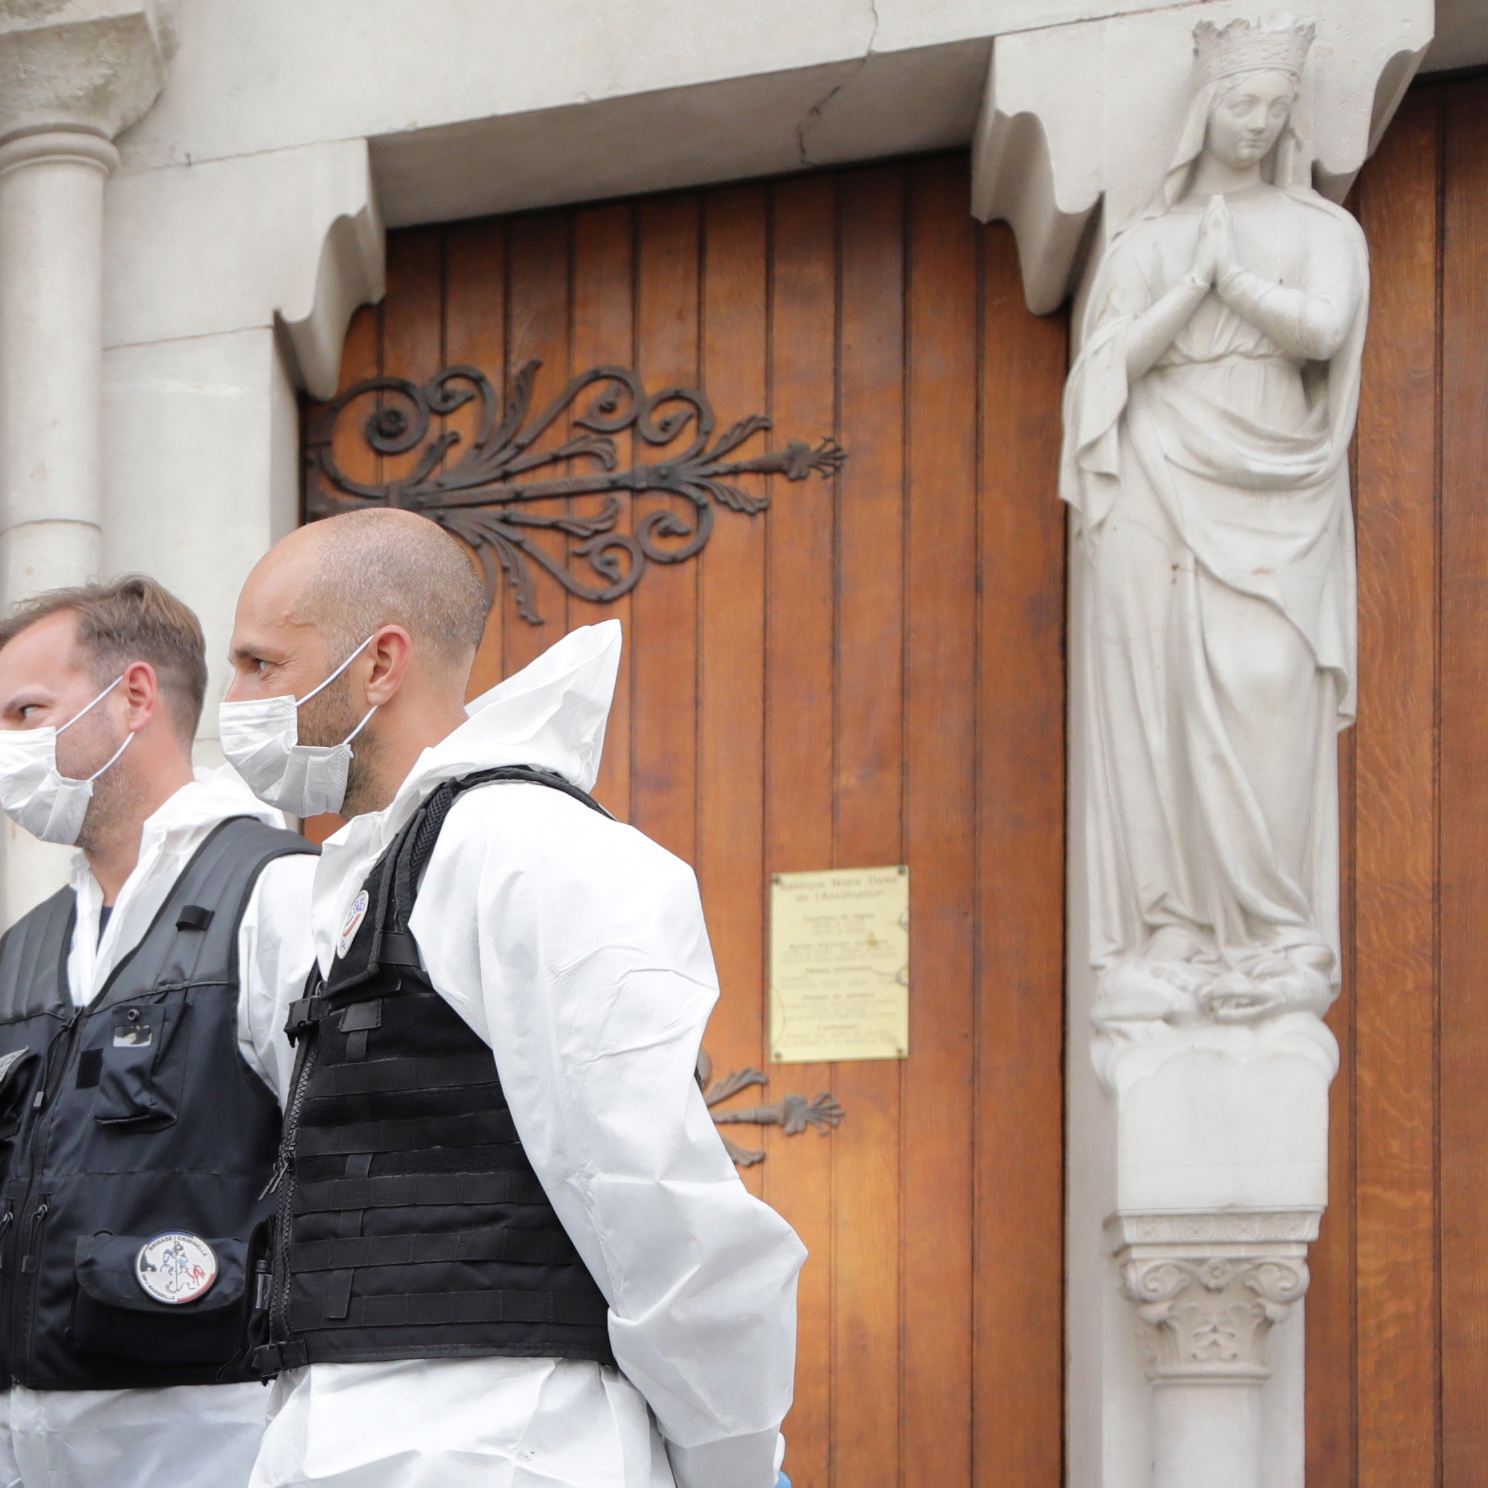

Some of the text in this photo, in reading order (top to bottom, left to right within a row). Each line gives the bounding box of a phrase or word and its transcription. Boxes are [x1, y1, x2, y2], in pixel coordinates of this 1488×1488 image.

[148, 1236, 208, 1257] BRIGADE CRIMINELLE
[148, 1284, 175, 1300] MARSEILLE
